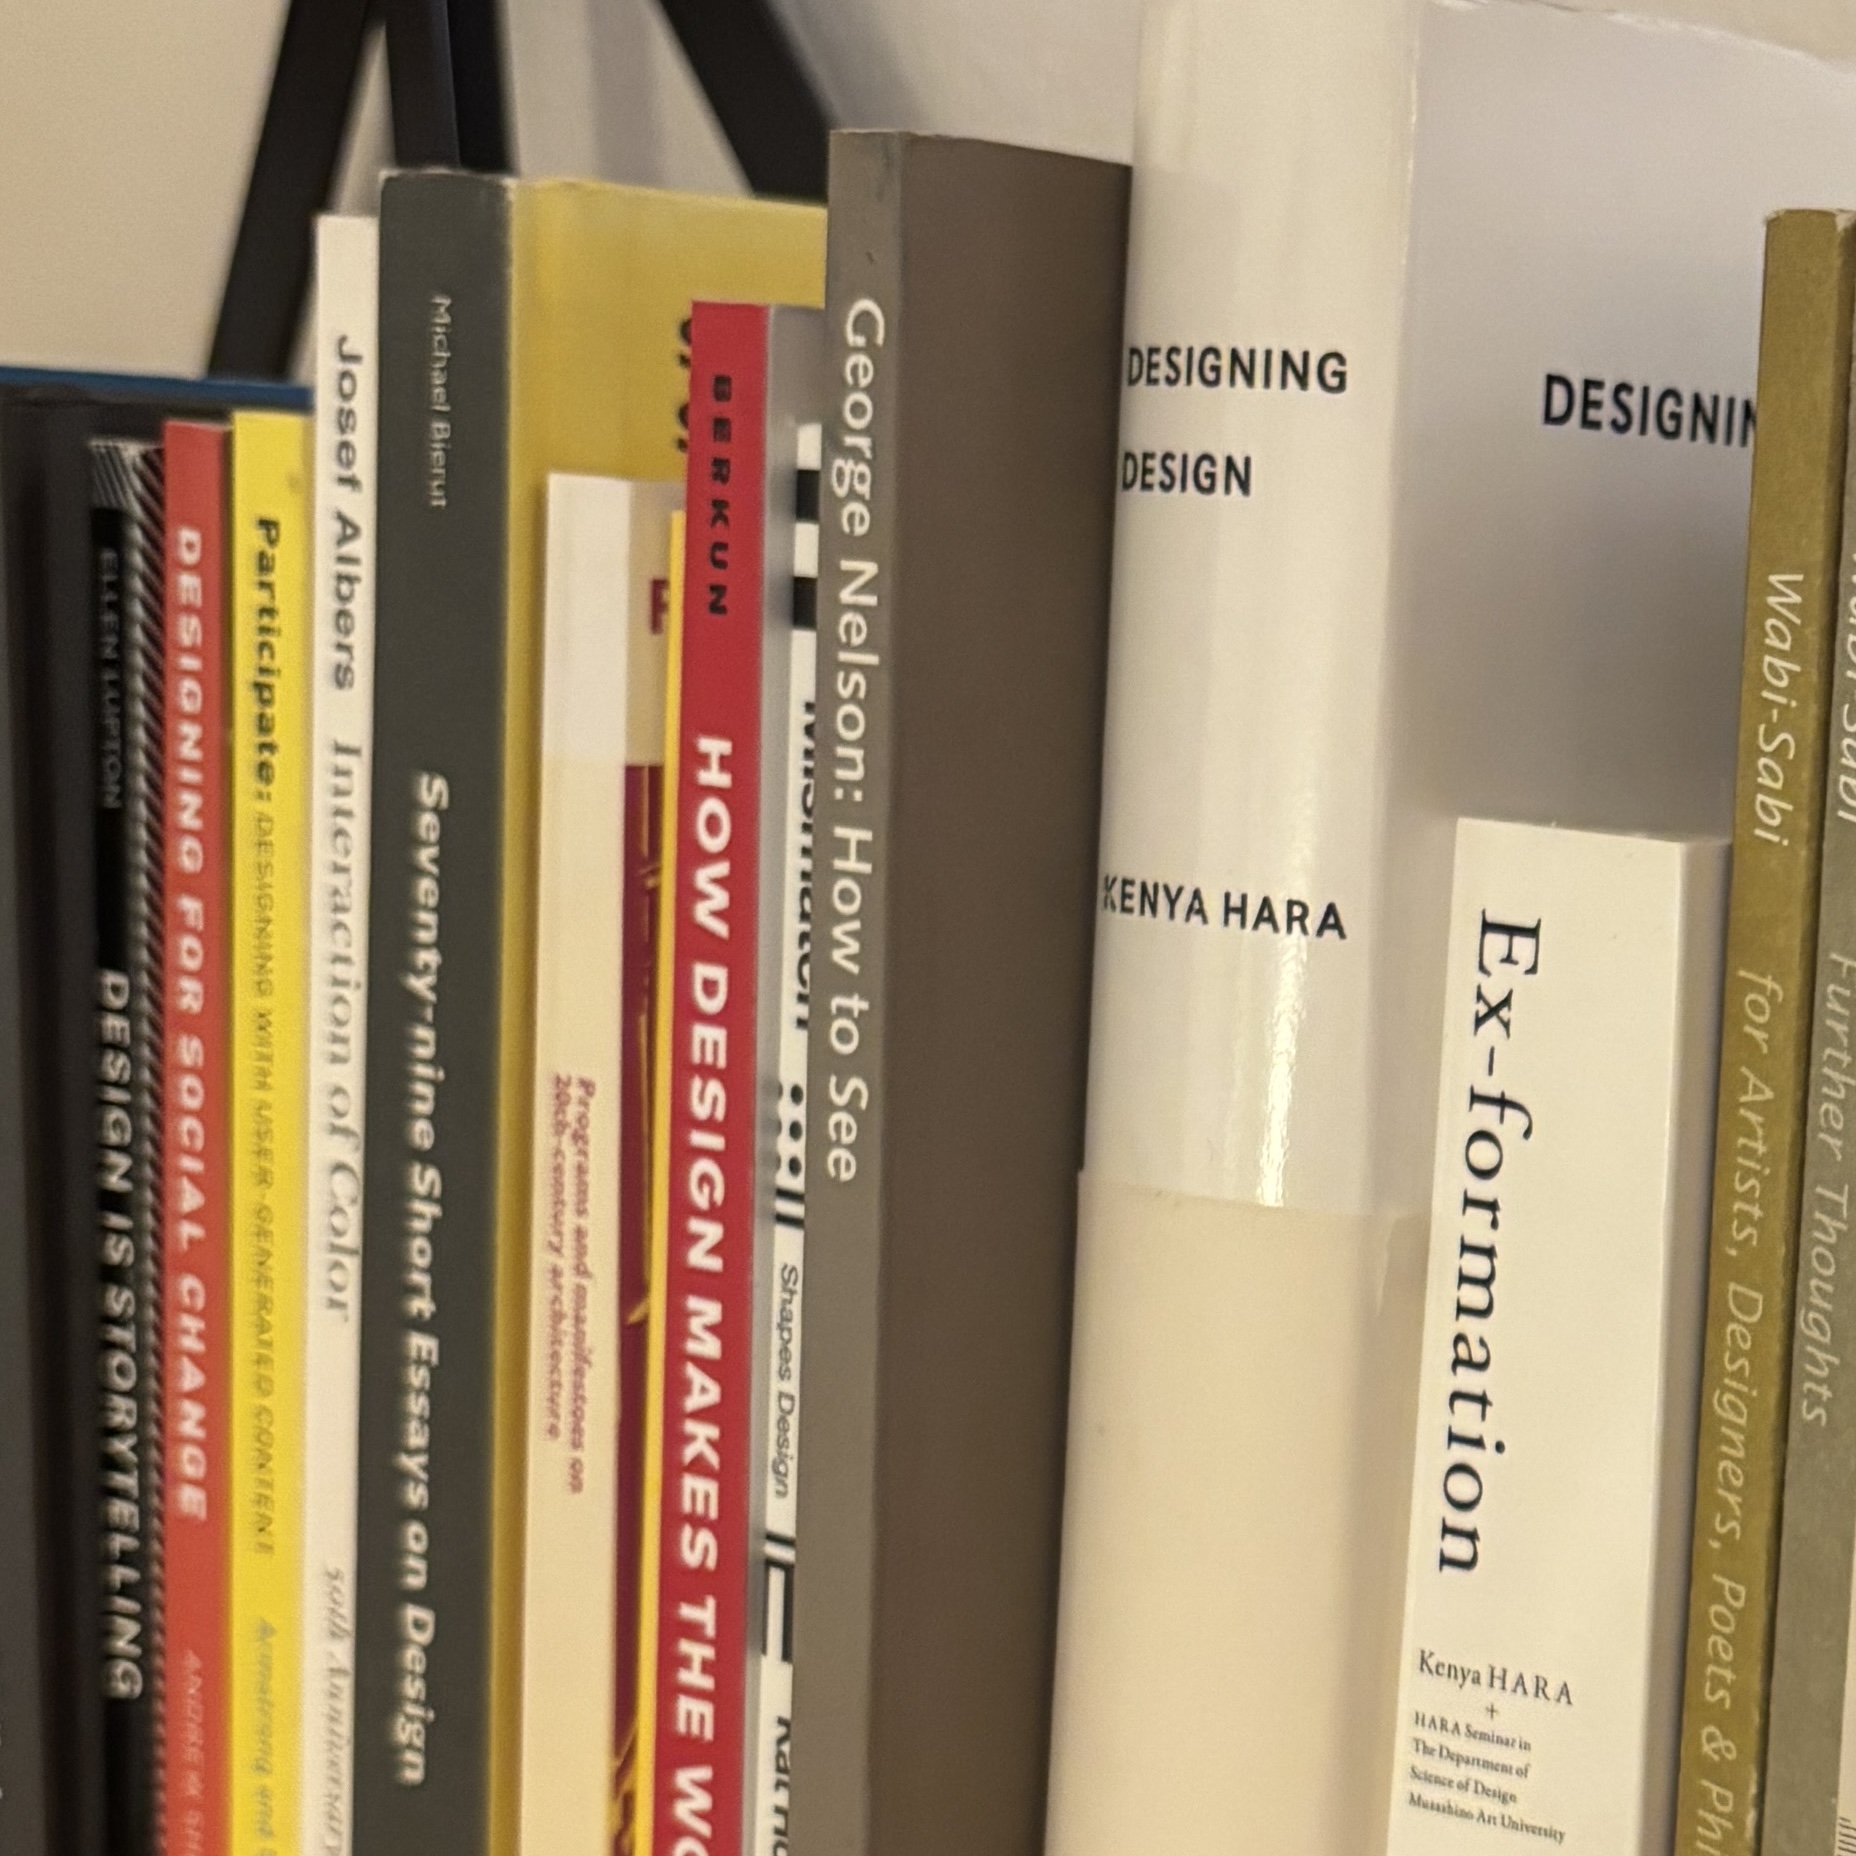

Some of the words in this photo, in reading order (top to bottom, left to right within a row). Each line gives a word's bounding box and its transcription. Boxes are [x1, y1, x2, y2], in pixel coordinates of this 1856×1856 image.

[333, 336, 362, 491] Josef
[430, 295, 452, 412] Michael
[830, 299, 886, 536] George
[1127, 347, 1348, 394] DESIGNING
[428, 422, 451, 508] Bierut
[709, 375, 731, 615] BERKUN
[1121, 452, 1252, 496] DESIGN
[250, 518, 281, 802] Participate:
[332, 512, 362, 690] Albers
[176, 526, 203, 874] DESIGNING
[832, 559, 881, 800] Nelson:
[1753, 571, 1805, 845] Wabi-Sabi
[327, 739, 361, 1066] Interaction
[695, 736, 731, 939] HOW
[830, 825, 873, 973] How
[1103, 874, 1208, 926] KENYA
[1222, 892, 1347, 940] HARA
[175, 895, 203, 1013] FOR
[397, 771, 448, 1149] Seventy-nine
[830, 995, 870, 1053] to
[1738, 970, 1781, 1044] for
[100, 969, 133, 1191] DESIGN
[176, 1034, 205, 1251] SOCIAL
[327, 1086, 361, 1142] of
[572, 1077, 595, 1217] Programs
[686, 962, 728, 1270] DESIGN
[827, 1075, 869, 1181] See
[101, 1212, 134, 1265] IS
[1726, 1066, 1774, 1256] Artists,
[326, 1162, 359, 1322] Color
[408, 1163, 442, 1318] Short
[574, 1224, 593, 1276] and
[1437, 910, 1541, 1576] Ex-formation
[1800, 1182, 1849, 1425] Thoughts
[178, 1273, 207, 1522] CHANGE
[547, 1263, 567, 1442] architecture
[571, 1282, 591, 1452] manifestoes
[777, 1263, 799, 1381] Shapes
[101, 1285, 142, 1698] STORYTELLING
[393, 1329, 438, 1508] Essays
[570, 1456, 585, 1494] on
[680, 1295, 723, 1569] MAKES
[772, 1391, 795, 1498] Design
[1708, 1282, 1764, 1551] Designers,
[404, 1520, 431, 1590] on
[391, 1602, 435, 1784] Design
[676, 1594, 716, 1740] THE
[1419, 1648, 1482, 1689] Kenya
[1489, 1664, 1574, 1706] HARA
[1703, 1573, 1746, 1702] Poets
[1410, 1766, 1454, 1789] Science
[1457, 1778, 1471, 1792] of
[1474, 1780, 1517, 1805] Design
[1413, 1738, 1436, 1757] The
[1438, 1745, 1514, 1774] Department
[1515, 1762, 1531, 1779] of
[1414, 1711, 1461, 1736] HARA
[1464, 1724, 1516, 1748] Seminar
[1518, 1735, 1531, 1751] in
[1701, 1725, 1736, 1764] &
[1408, 1793, 1475, 1819] Musashino
[1477, 1809, 1497, 1827] Art
[1501, 1815, 1566, 1845] University
